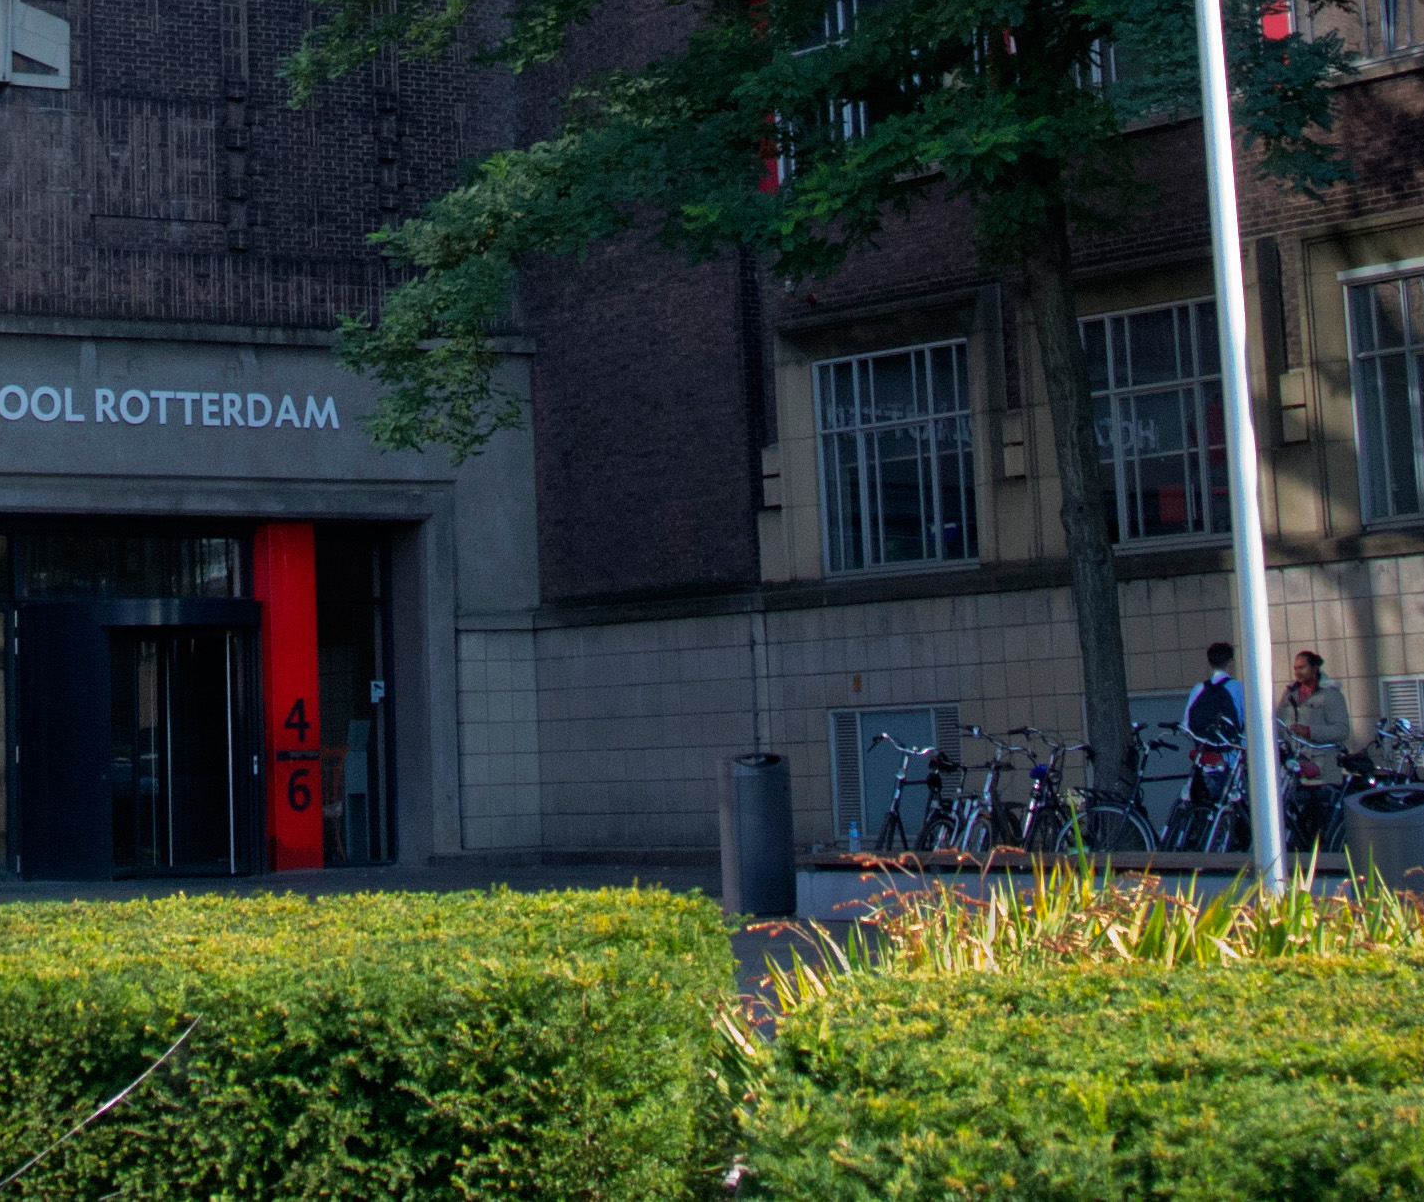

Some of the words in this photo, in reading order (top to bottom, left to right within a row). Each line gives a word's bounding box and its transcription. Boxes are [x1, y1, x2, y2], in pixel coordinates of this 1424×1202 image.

[95, 388, 340, 429] ROTTERDAM
[284, 698, 310, 741] 4
[288, 768, 311, 812] 6
